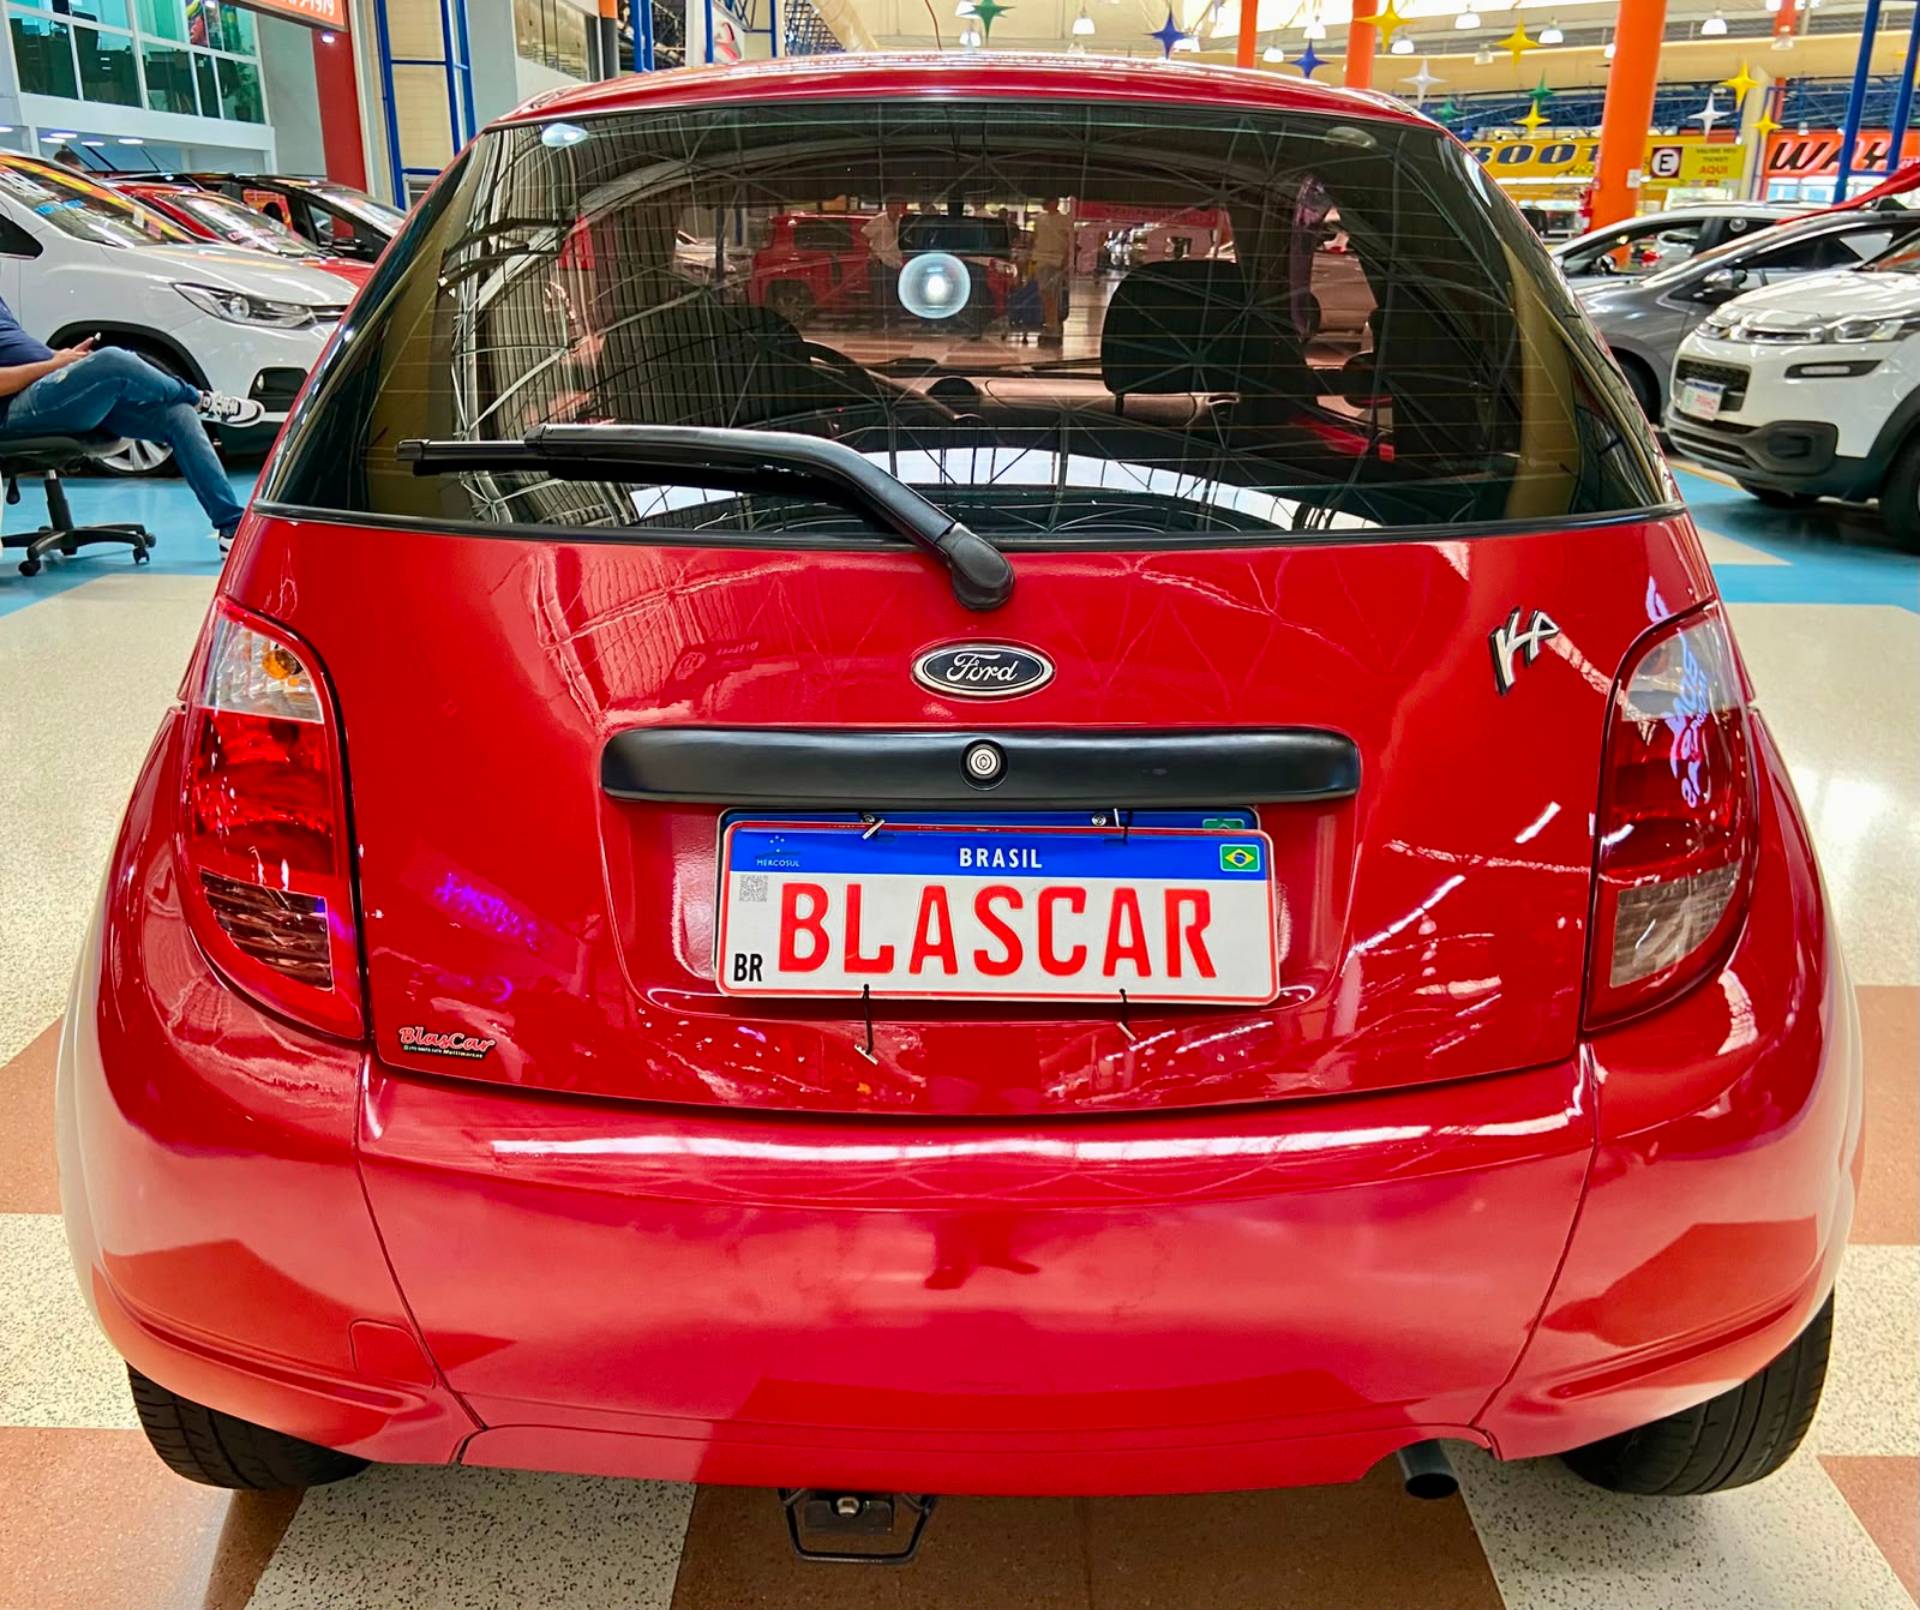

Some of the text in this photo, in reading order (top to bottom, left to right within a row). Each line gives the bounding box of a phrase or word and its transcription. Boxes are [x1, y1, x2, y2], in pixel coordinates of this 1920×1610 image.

[1659, 153, 1674, 172] E
[1490, 607, 1560, 694] KA
[946, 653, 1020, 682] Ford
[756, 858, 800, 868] MERCOSUL
[959, 847, 1043, 869] BRASIL
[777, 882, 1217, 978] BLASCAR
[733, 952, 763, 983] BR
[398, 1026, 496, 1053] BlasCar
